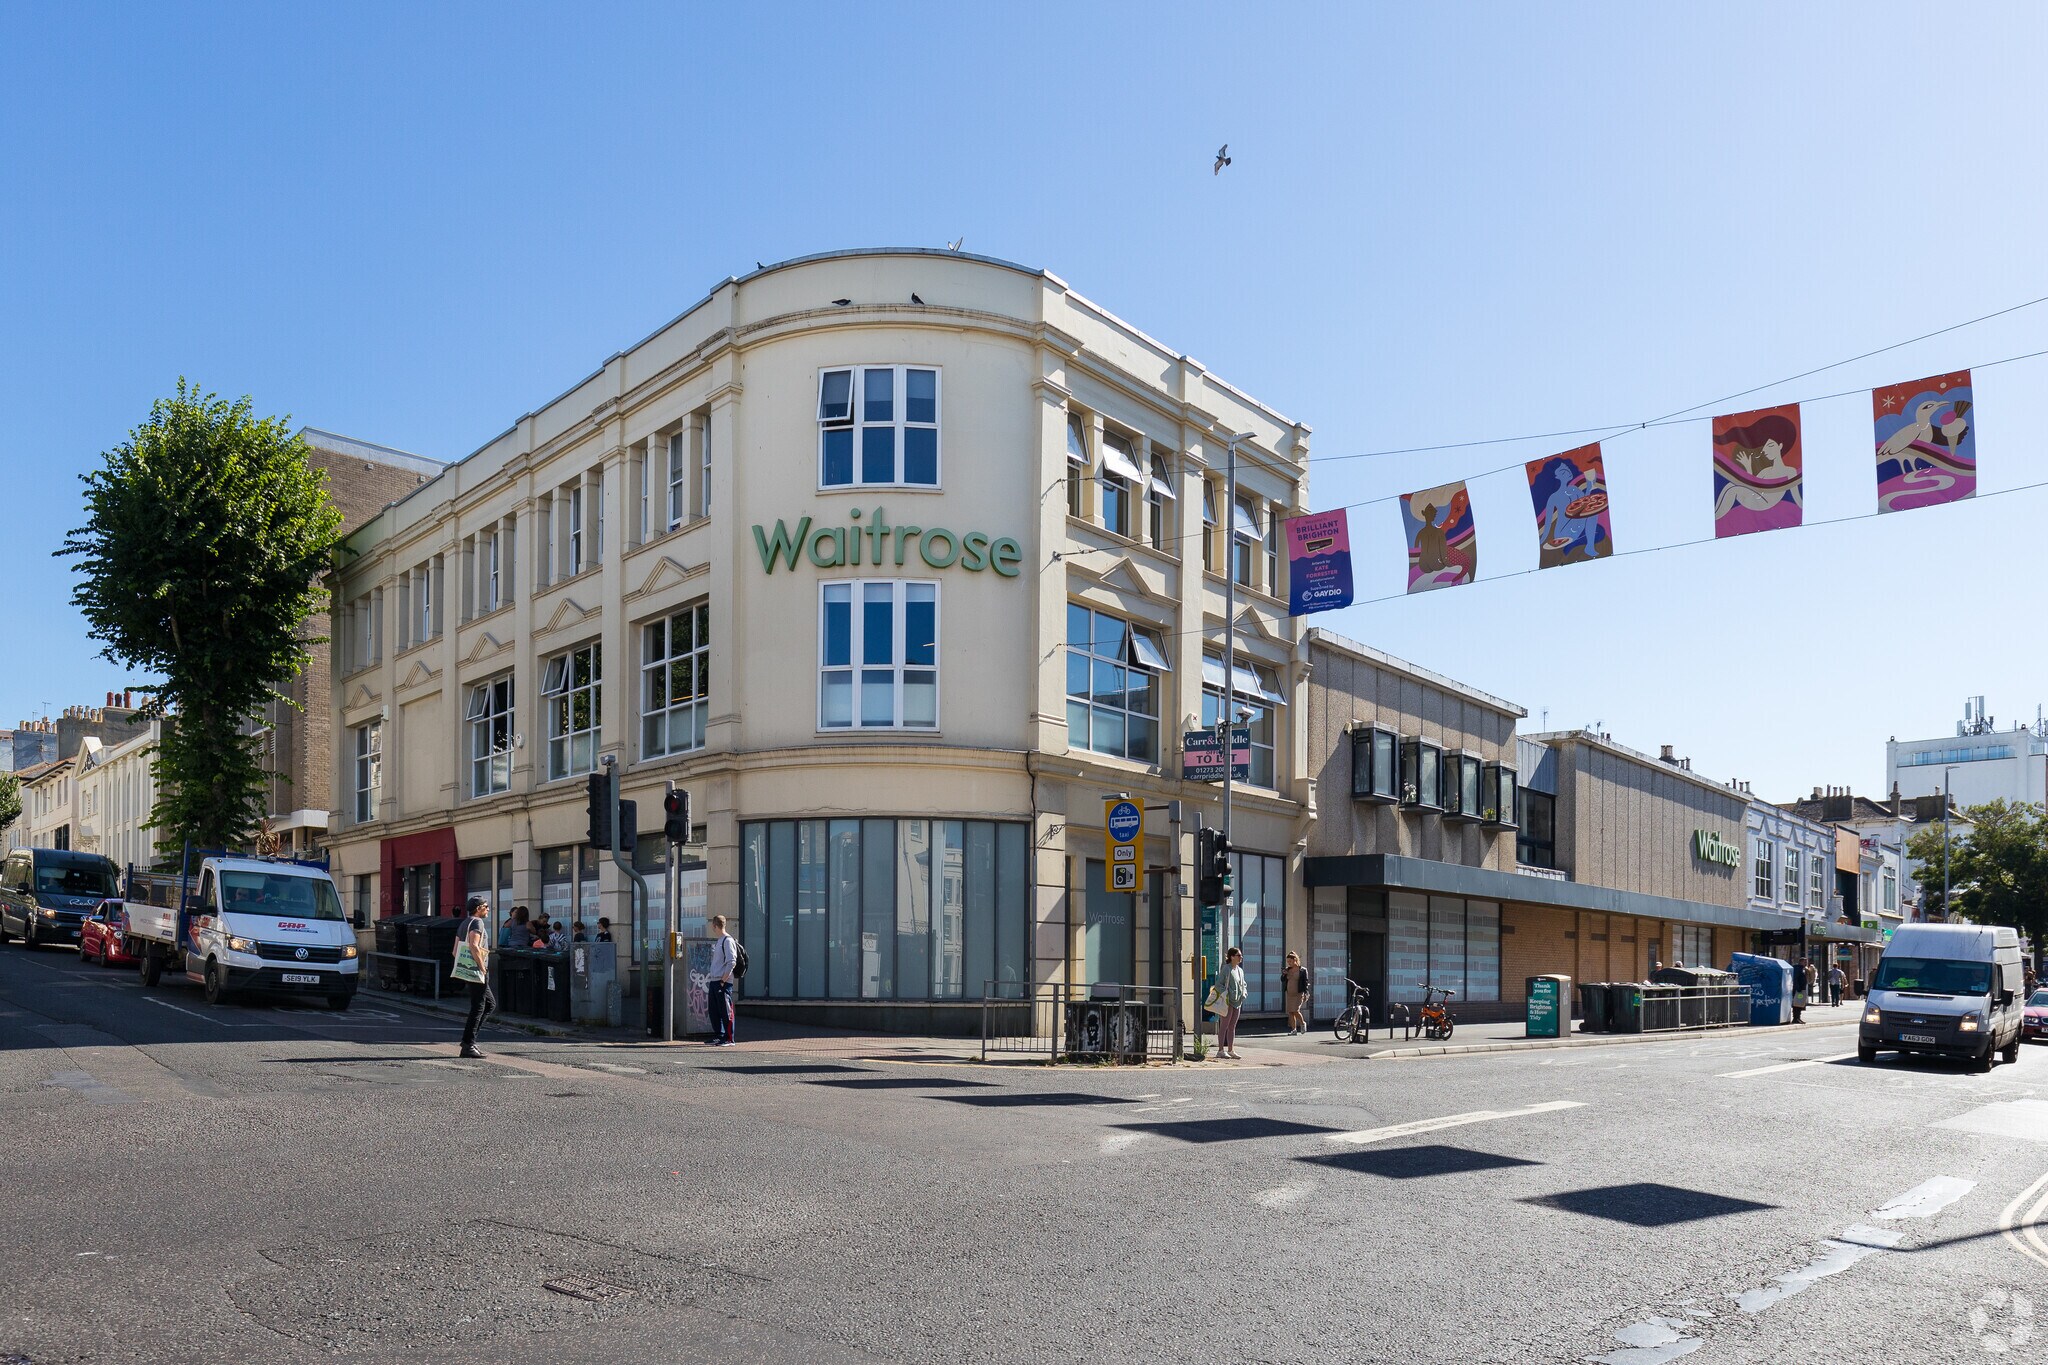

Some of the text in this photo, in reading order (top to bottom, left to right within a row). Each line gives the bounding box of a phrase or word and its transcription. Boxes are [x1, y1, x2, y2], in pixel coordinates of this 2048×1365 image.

[1296, 520, 1338, 534] BRILLIANT
[1297, 528, 1339, 541] BRIGHTON
[752, 506, 1022, 577] Waitrose
[1314, 588, 1342, 598] GAYDIO
[1196, 754, 1237, 764] TO LT
[1116, 849, 1133, 858] Only
[1693, 829, 1741, 868] Waitrose
[1089, 911, 1125, 925] Waitrose
